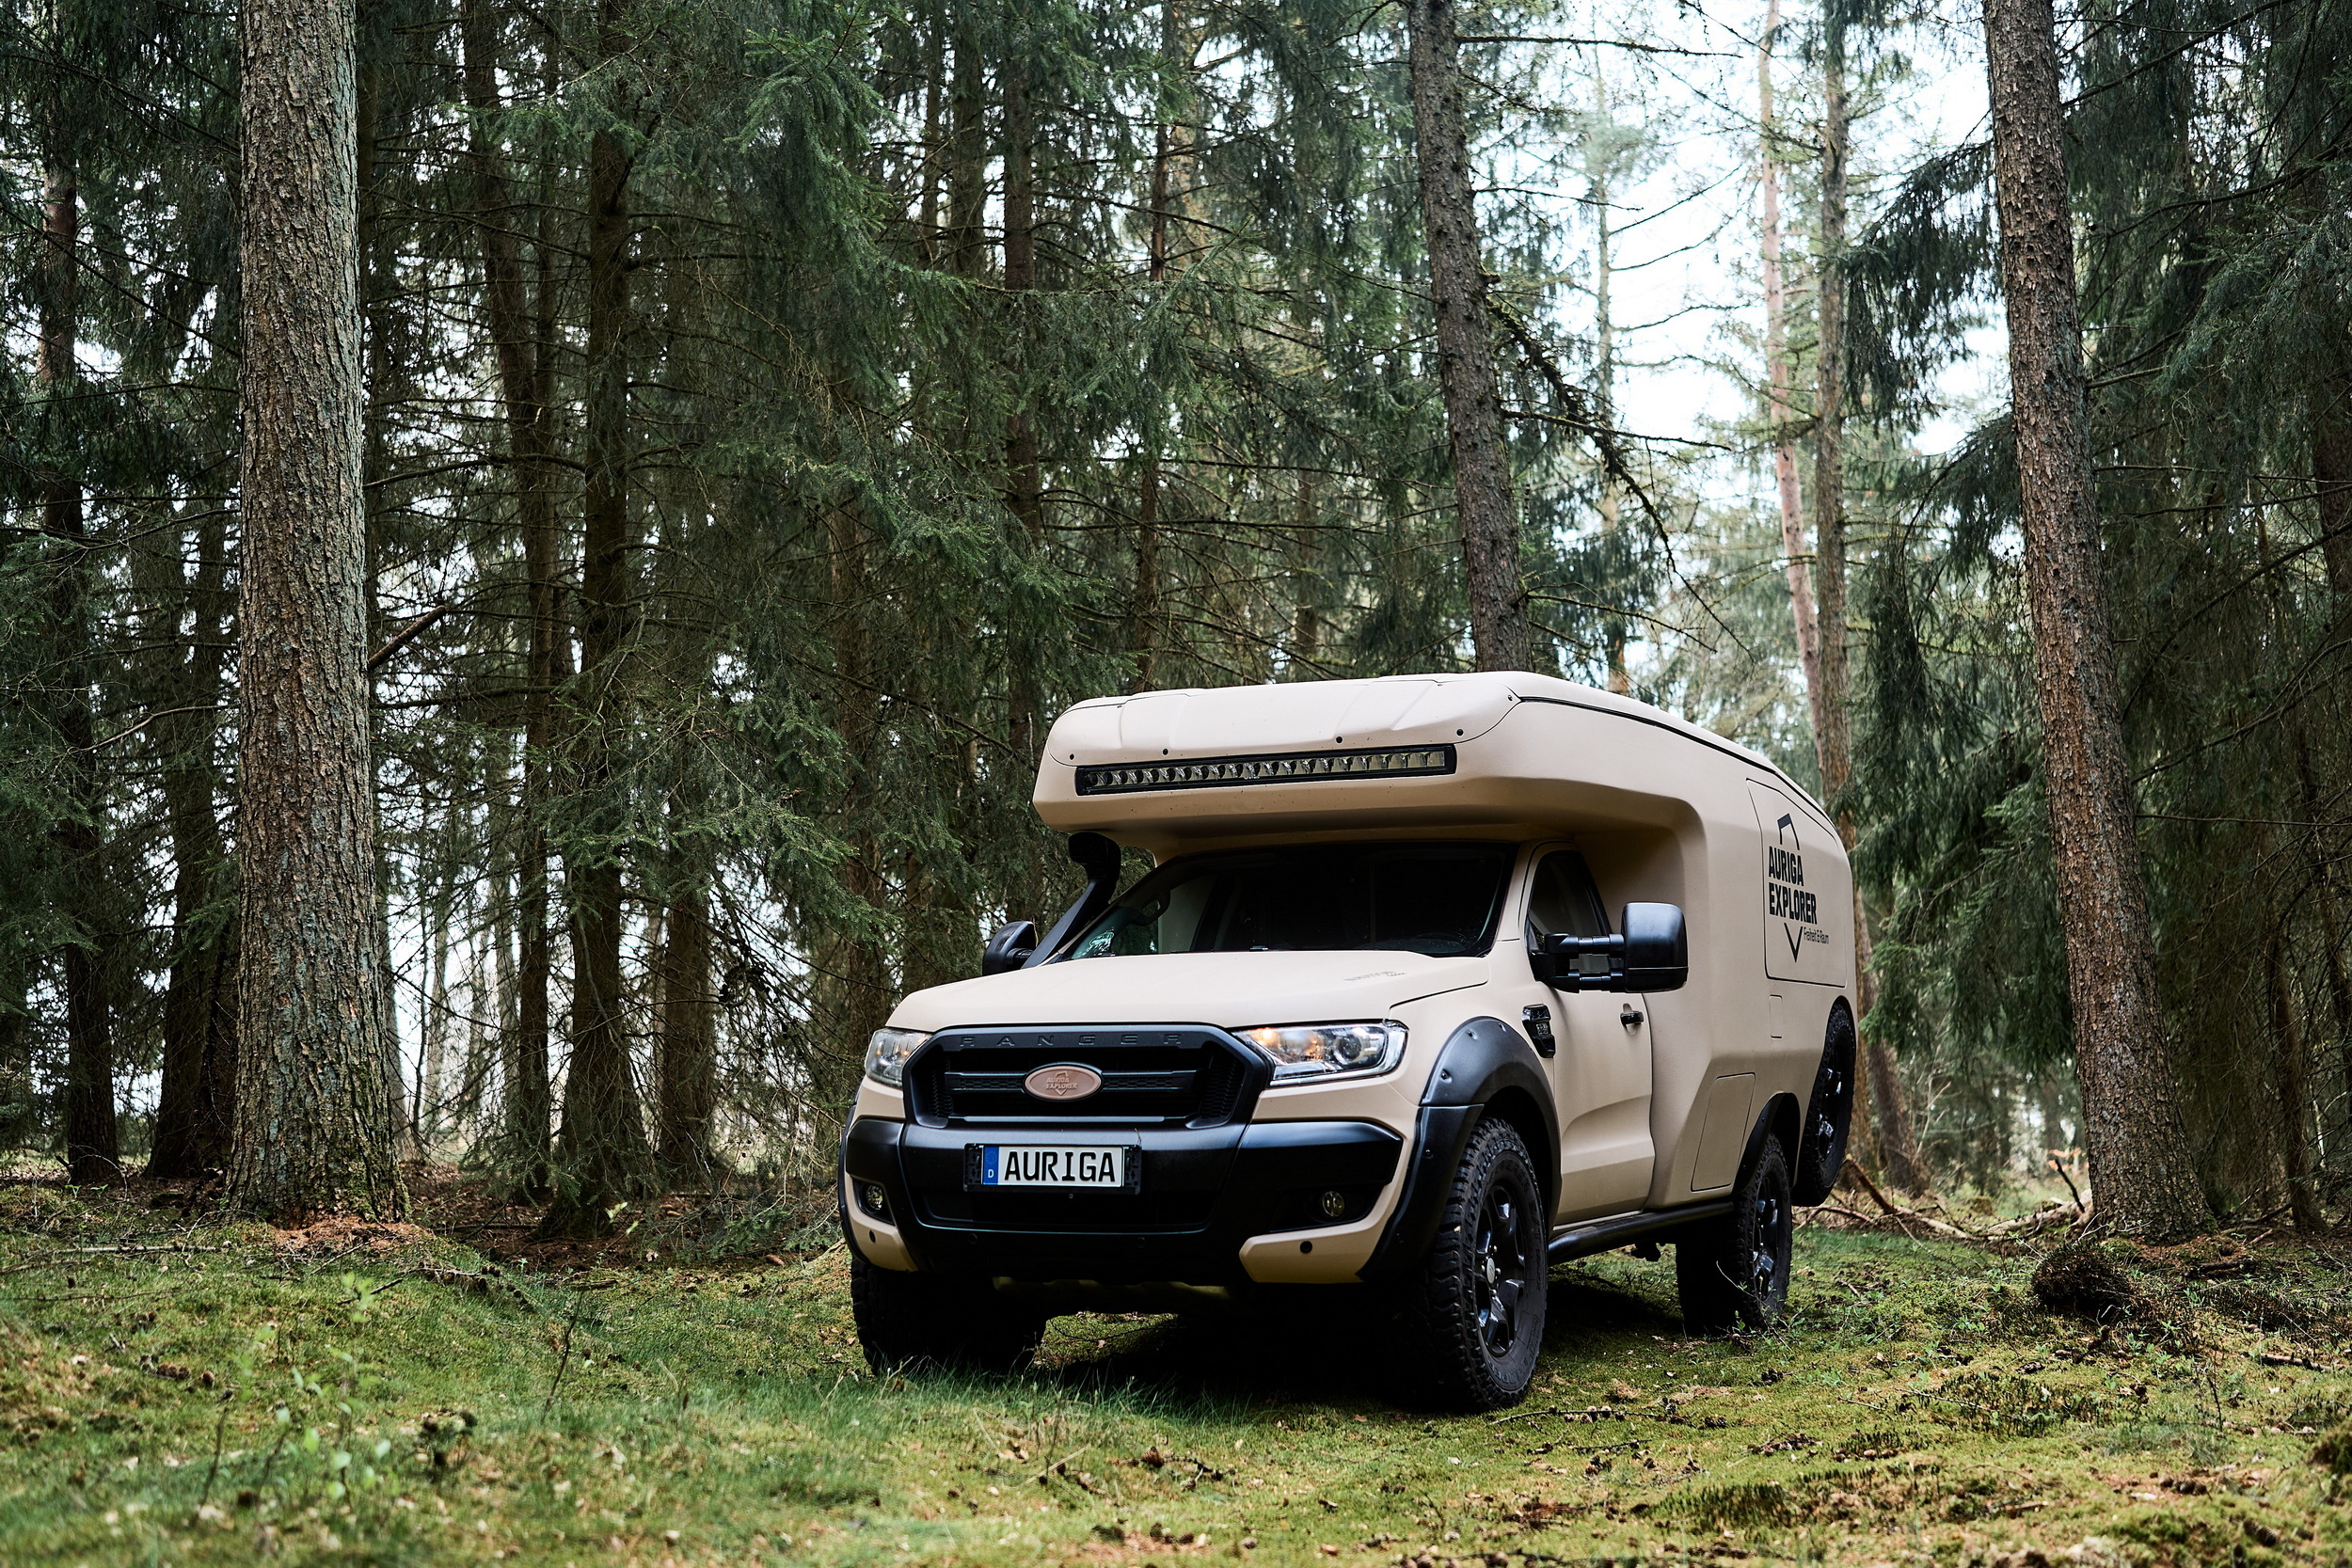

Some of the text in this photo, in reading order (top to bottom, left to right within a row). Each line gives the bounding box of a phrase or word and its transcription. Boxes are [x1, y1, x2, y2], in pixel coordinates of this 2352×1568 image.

[1769, 846, 1804, 886] AURIGA
[1769, 882, 1818, 925] EXPLORER
[960, 1034, 1182, 1047] RANGER
[988, 1169, 994, 1179] D
[1004, 1151, 1116, 1182] AURIGA
